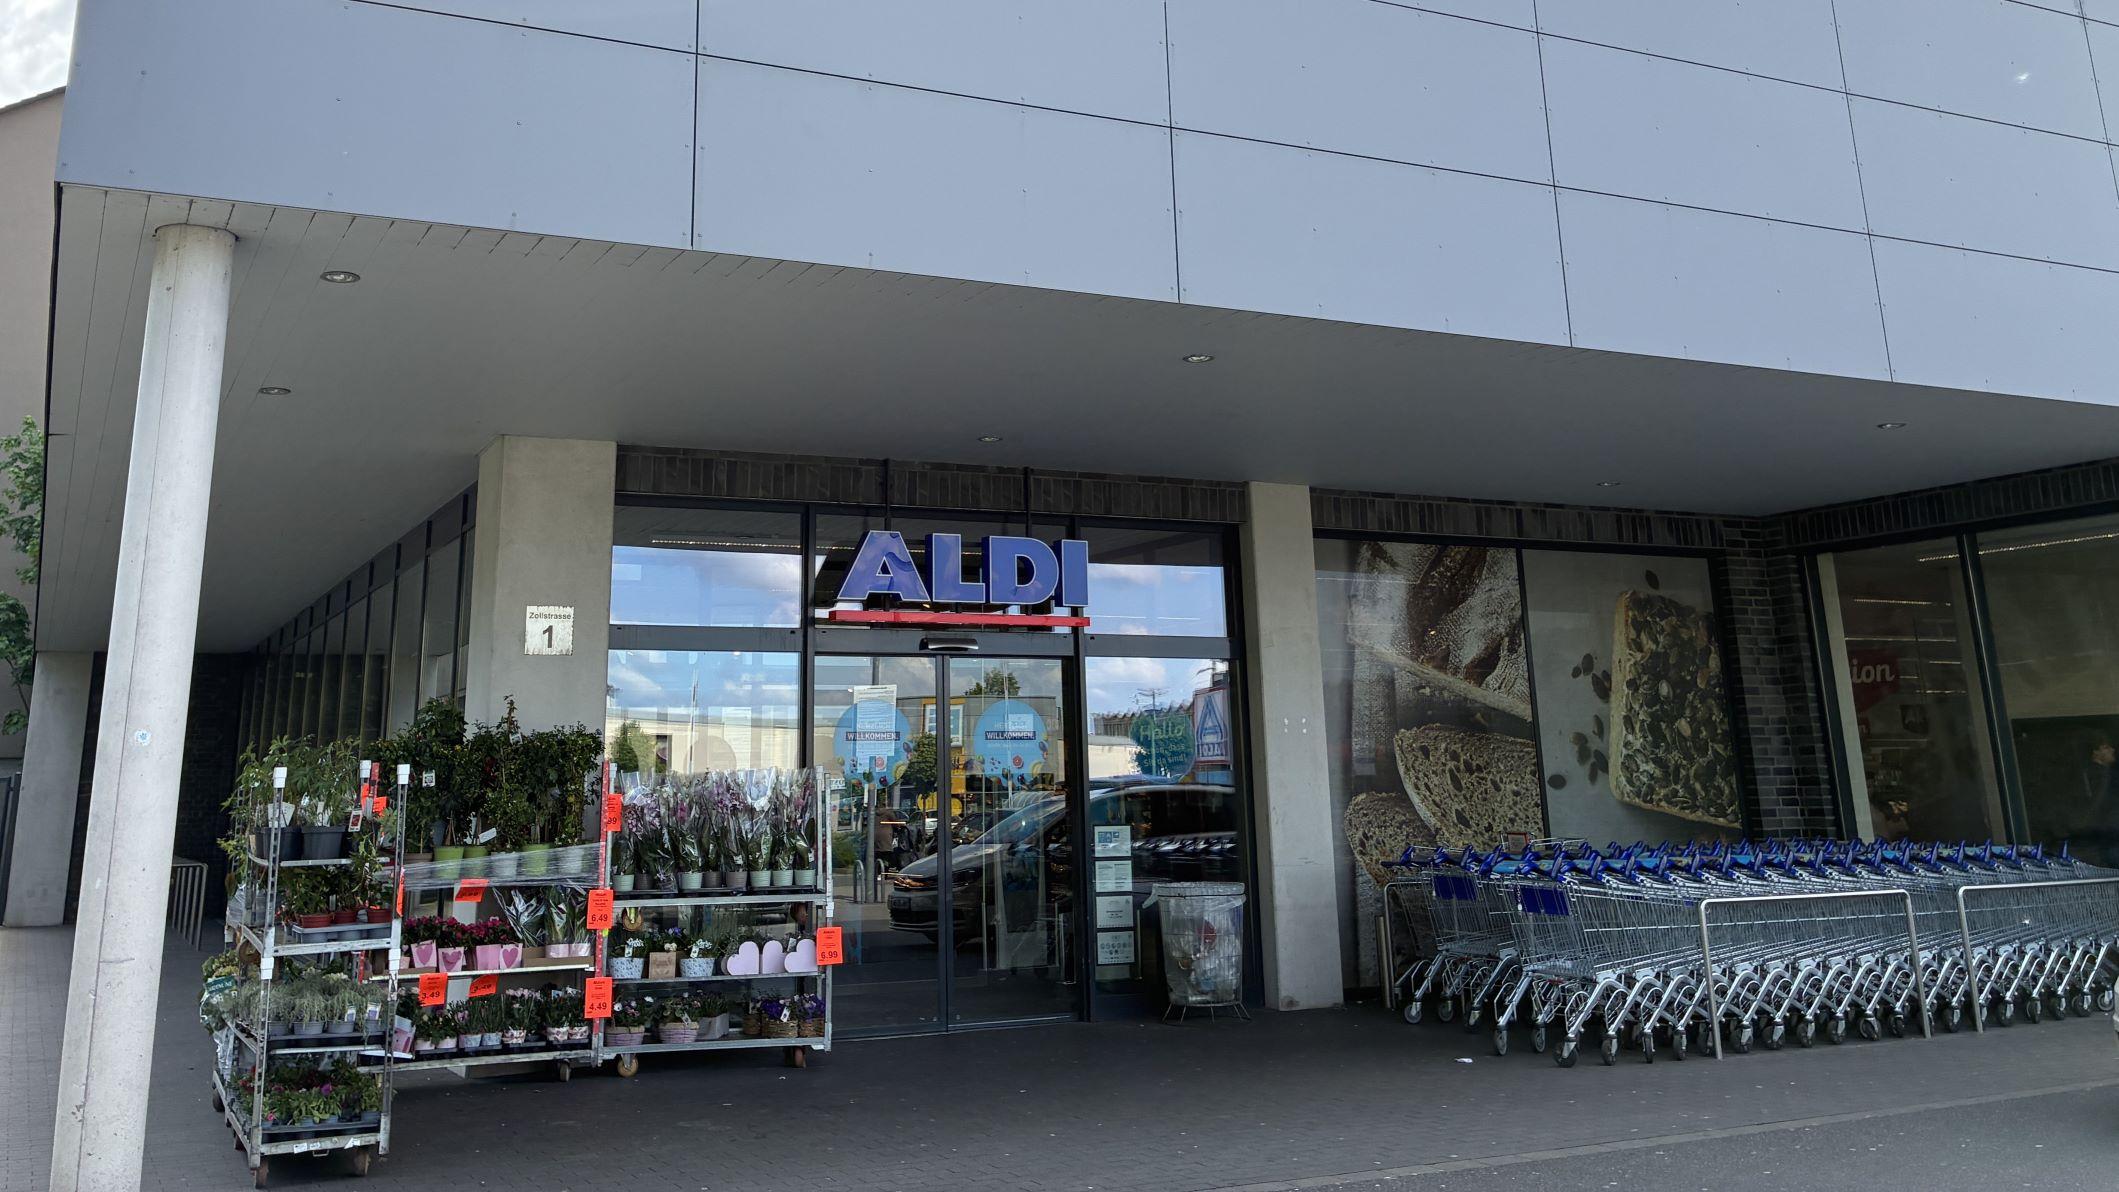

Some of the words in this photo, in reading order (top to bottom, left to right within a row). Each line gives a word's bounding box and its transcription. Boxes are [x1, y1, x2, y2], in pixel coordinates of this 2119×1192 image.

[836, 530, 1089, 607] ALDI
[542, 625, 553, 648] 1
[591, 913, 609, 923] 6.49
[421, 991, 440, 999] 3.49
[589, 1002, 607, 1010] 4.49
